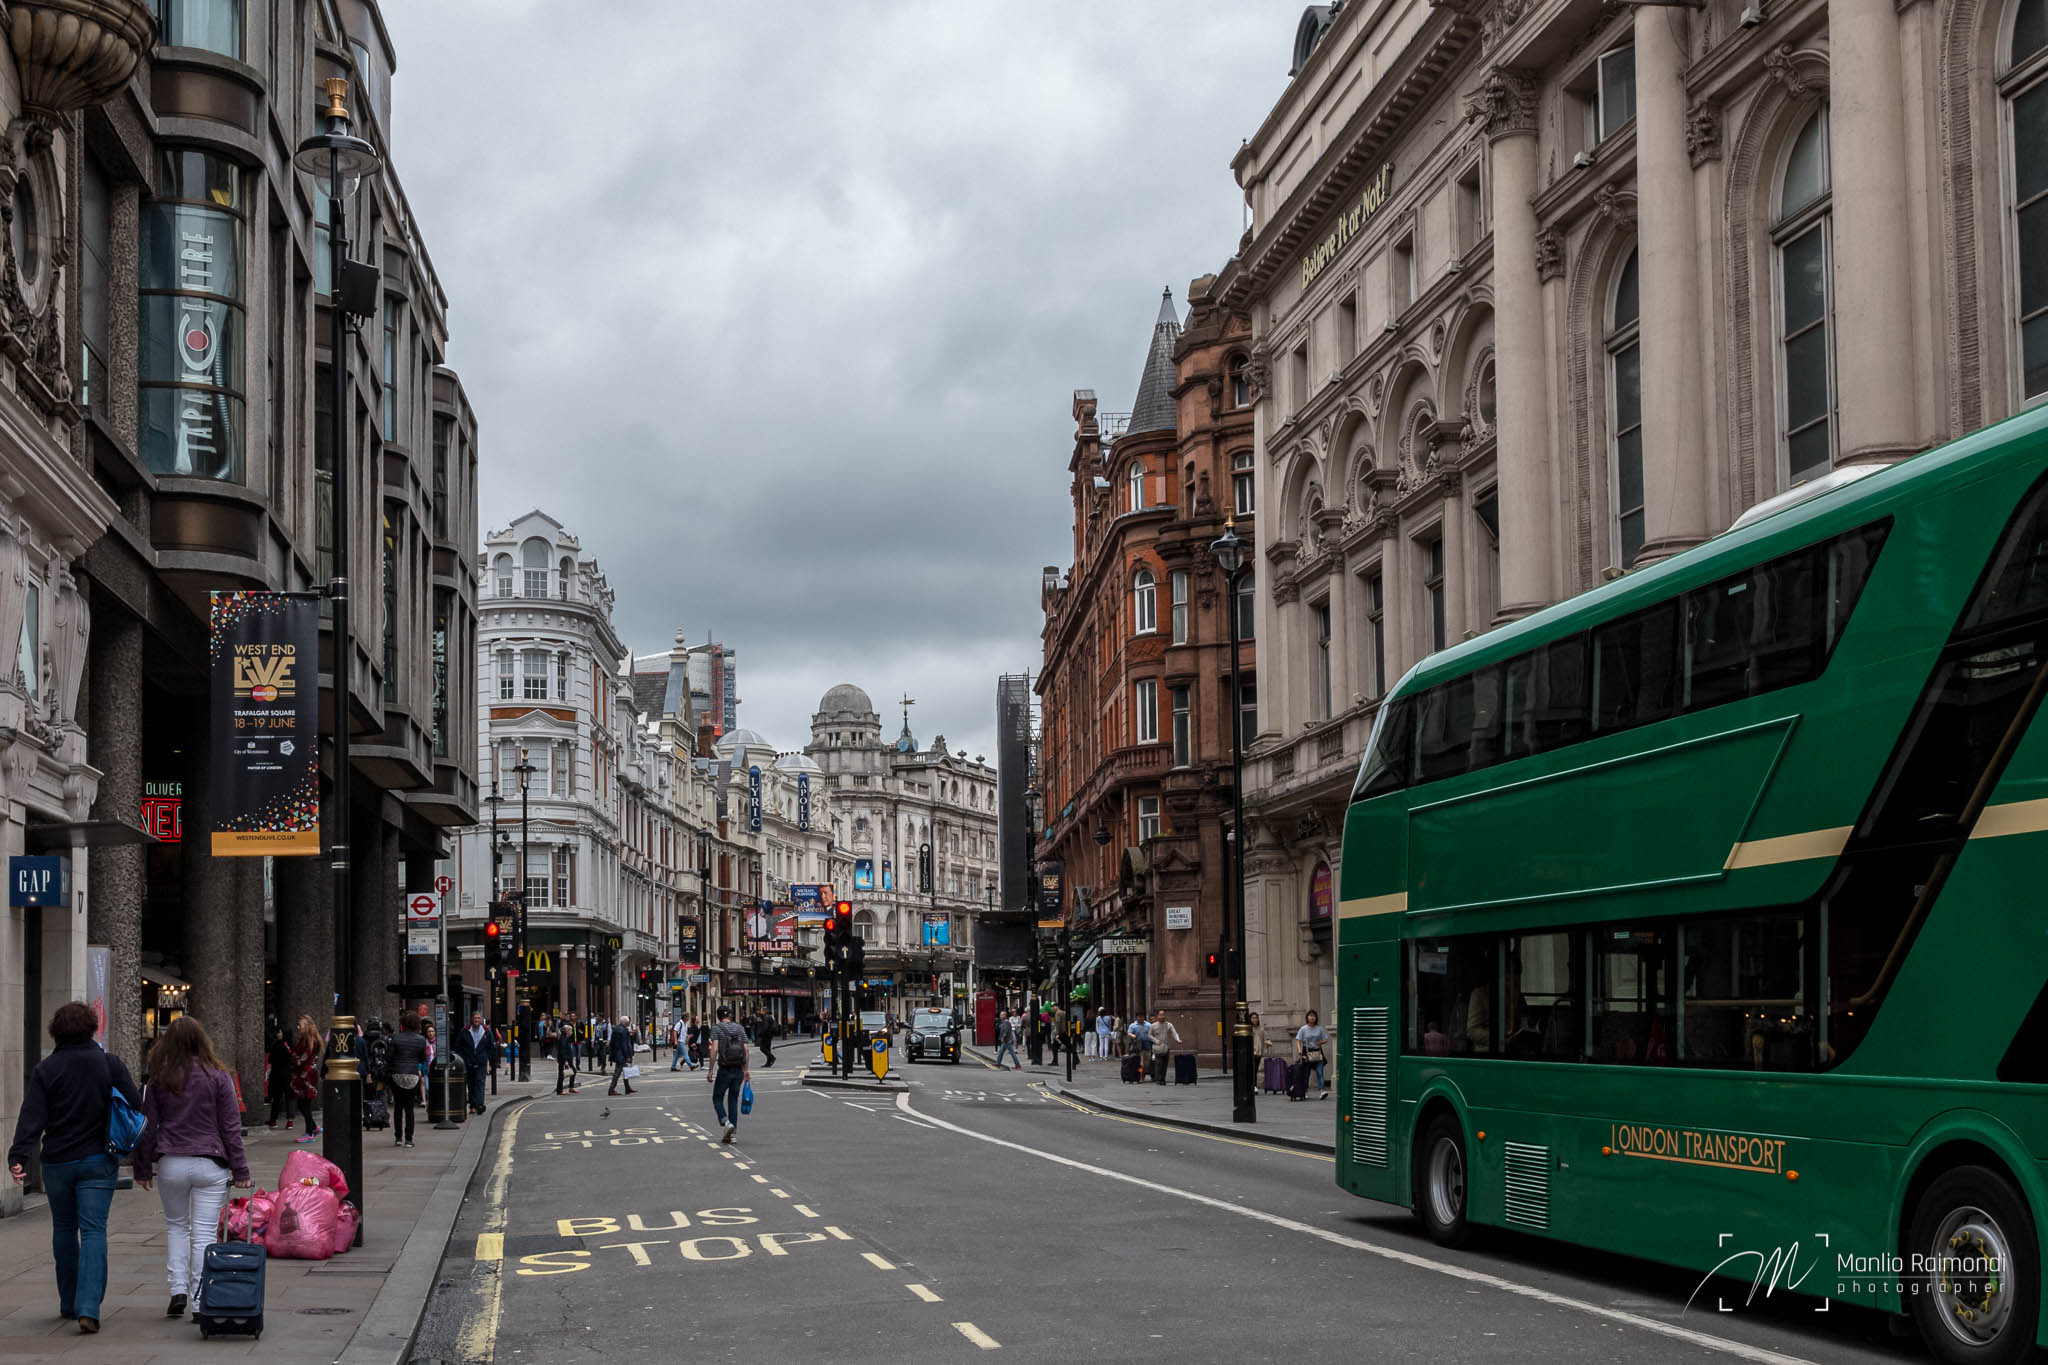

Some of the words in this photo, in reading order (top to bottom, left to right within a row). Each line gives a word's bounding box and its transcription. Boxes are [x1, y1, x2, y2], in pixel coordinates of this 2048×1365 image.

[1302, 233, 1335, 290] Believe
[1338, 212, 1348, 250] It
[1348, 204, 1361, 237] or
[1362, 163, 1390, 224] Not!
[234, 644, 268, 656] WEST
[271, 644, 296, 656] END
[234, 656, 296, 689] LIVE
[268, 717, 296, 729] JUNE
[270, 709, 296, 717] SQUARE
[145, 782, 182, 796] OLIVER
[750, 777, 760, 828] LYRIC
[799, 780, 809, 830] APOLLO
[19, 869, 51, 893] GAP
[747, 941, 794, 951] THRILLER
[526, 1135, 689, 1151] STOP
[544, 1127, 659, 1140] BUS
[1612, 1124, 1679, 1156] LONDON
[1682, 1131, 1787, 1174] TRANSPORT
[556, 1207, 759, 1237] BUS
[515, 1232, 828, 1276] STOP
